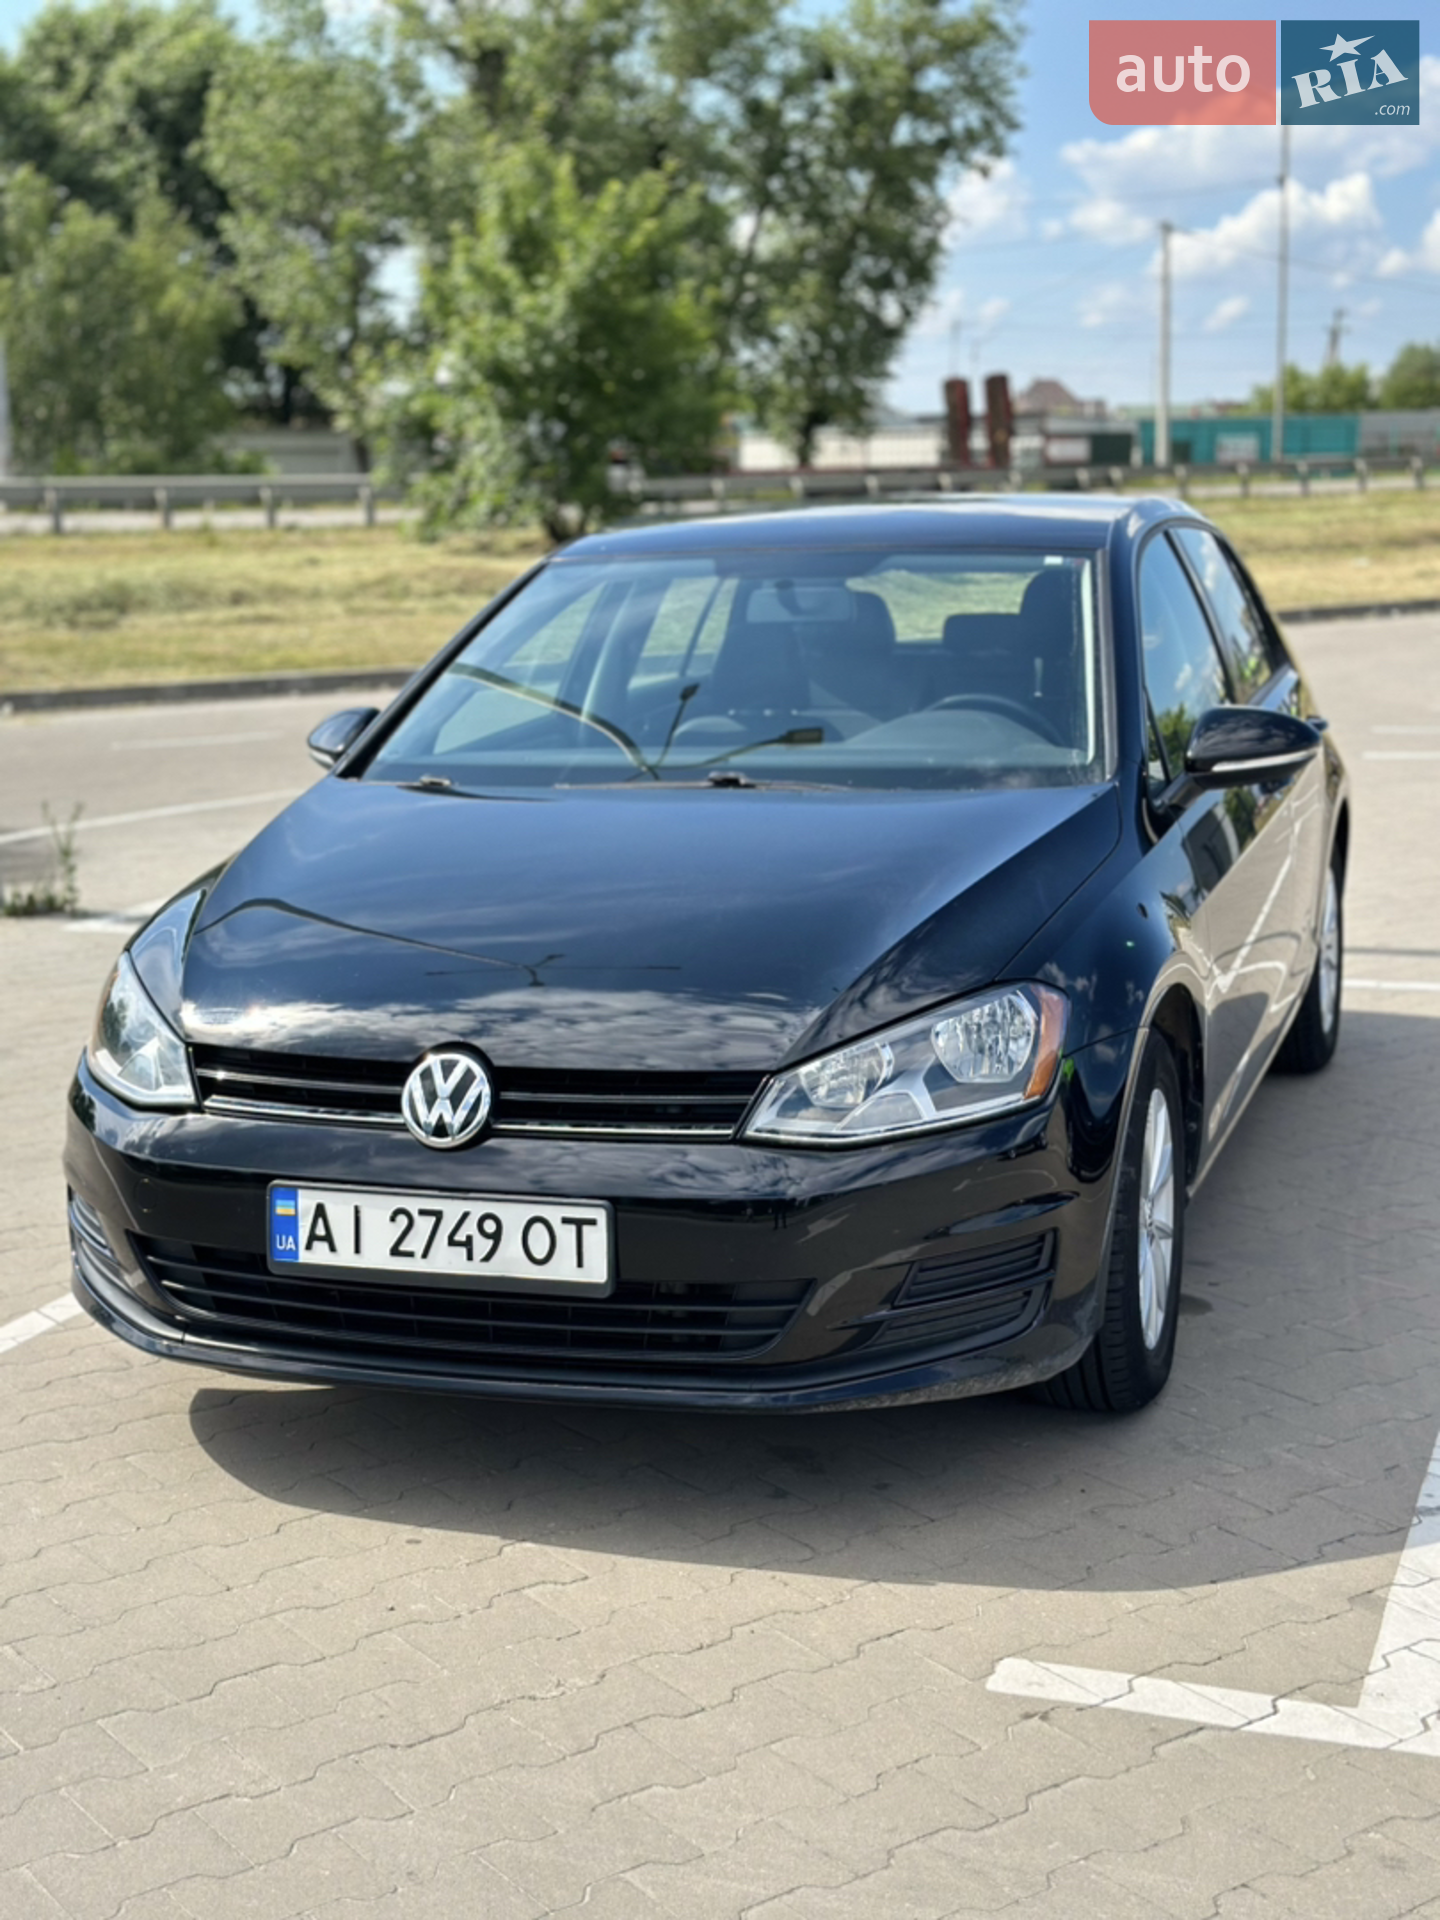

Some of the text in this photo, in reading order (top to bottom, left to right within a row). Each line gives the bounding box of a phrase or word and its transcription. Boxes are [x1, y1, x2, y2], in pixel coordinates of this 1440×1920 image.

[276, 1234, 296, 1251] UA
[304, 1202, 599, 1269] AI 2749 OT
